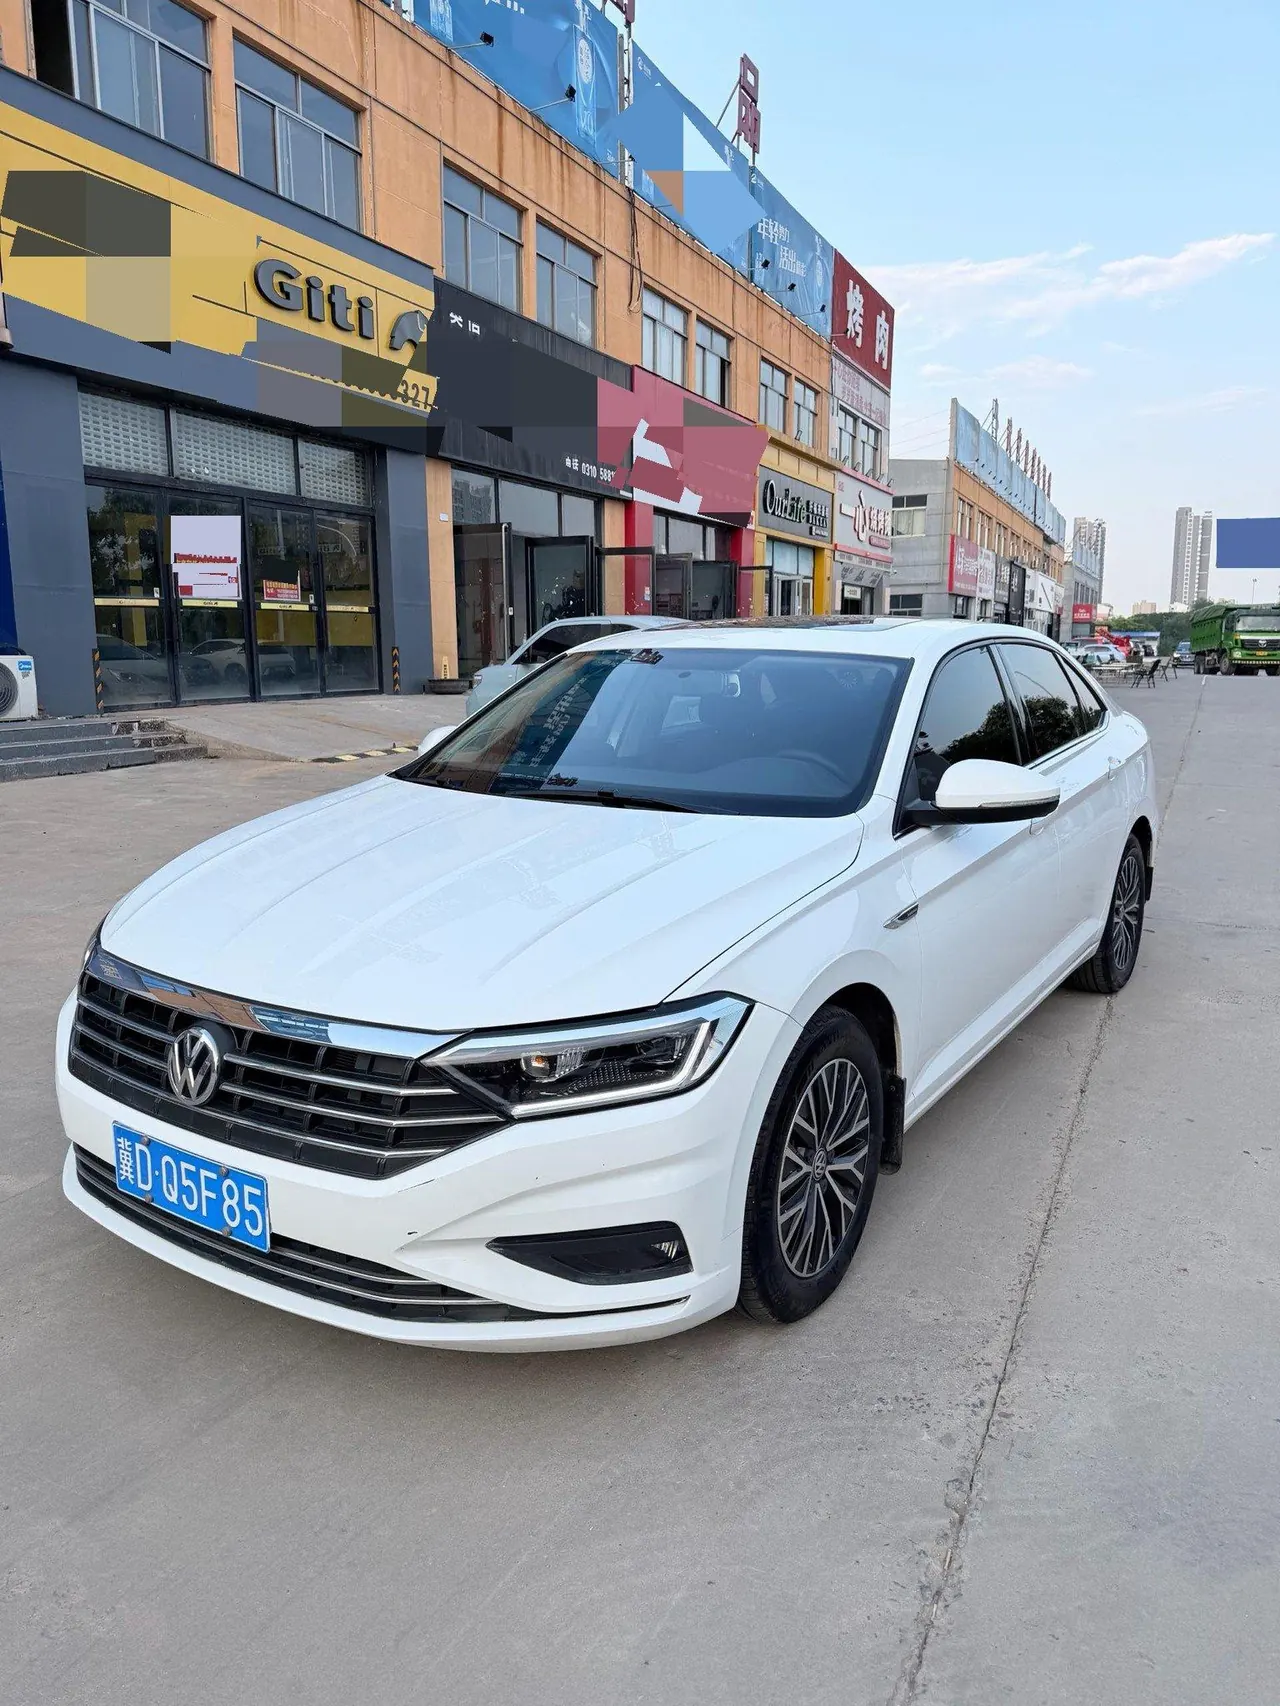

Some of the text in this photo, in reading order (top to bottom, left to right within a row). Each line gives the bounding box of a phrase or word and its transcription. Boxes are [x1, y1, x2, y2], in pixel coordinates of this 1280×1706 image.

[254, 259, 375, 340] Giti
[846, 279, 890, 370] 烤肉
[581, 463, 597, 478] 0310
[763, 479, 807, 523] OurLife
[116, 1136, 264, 1237] 冀D·Q5F85
